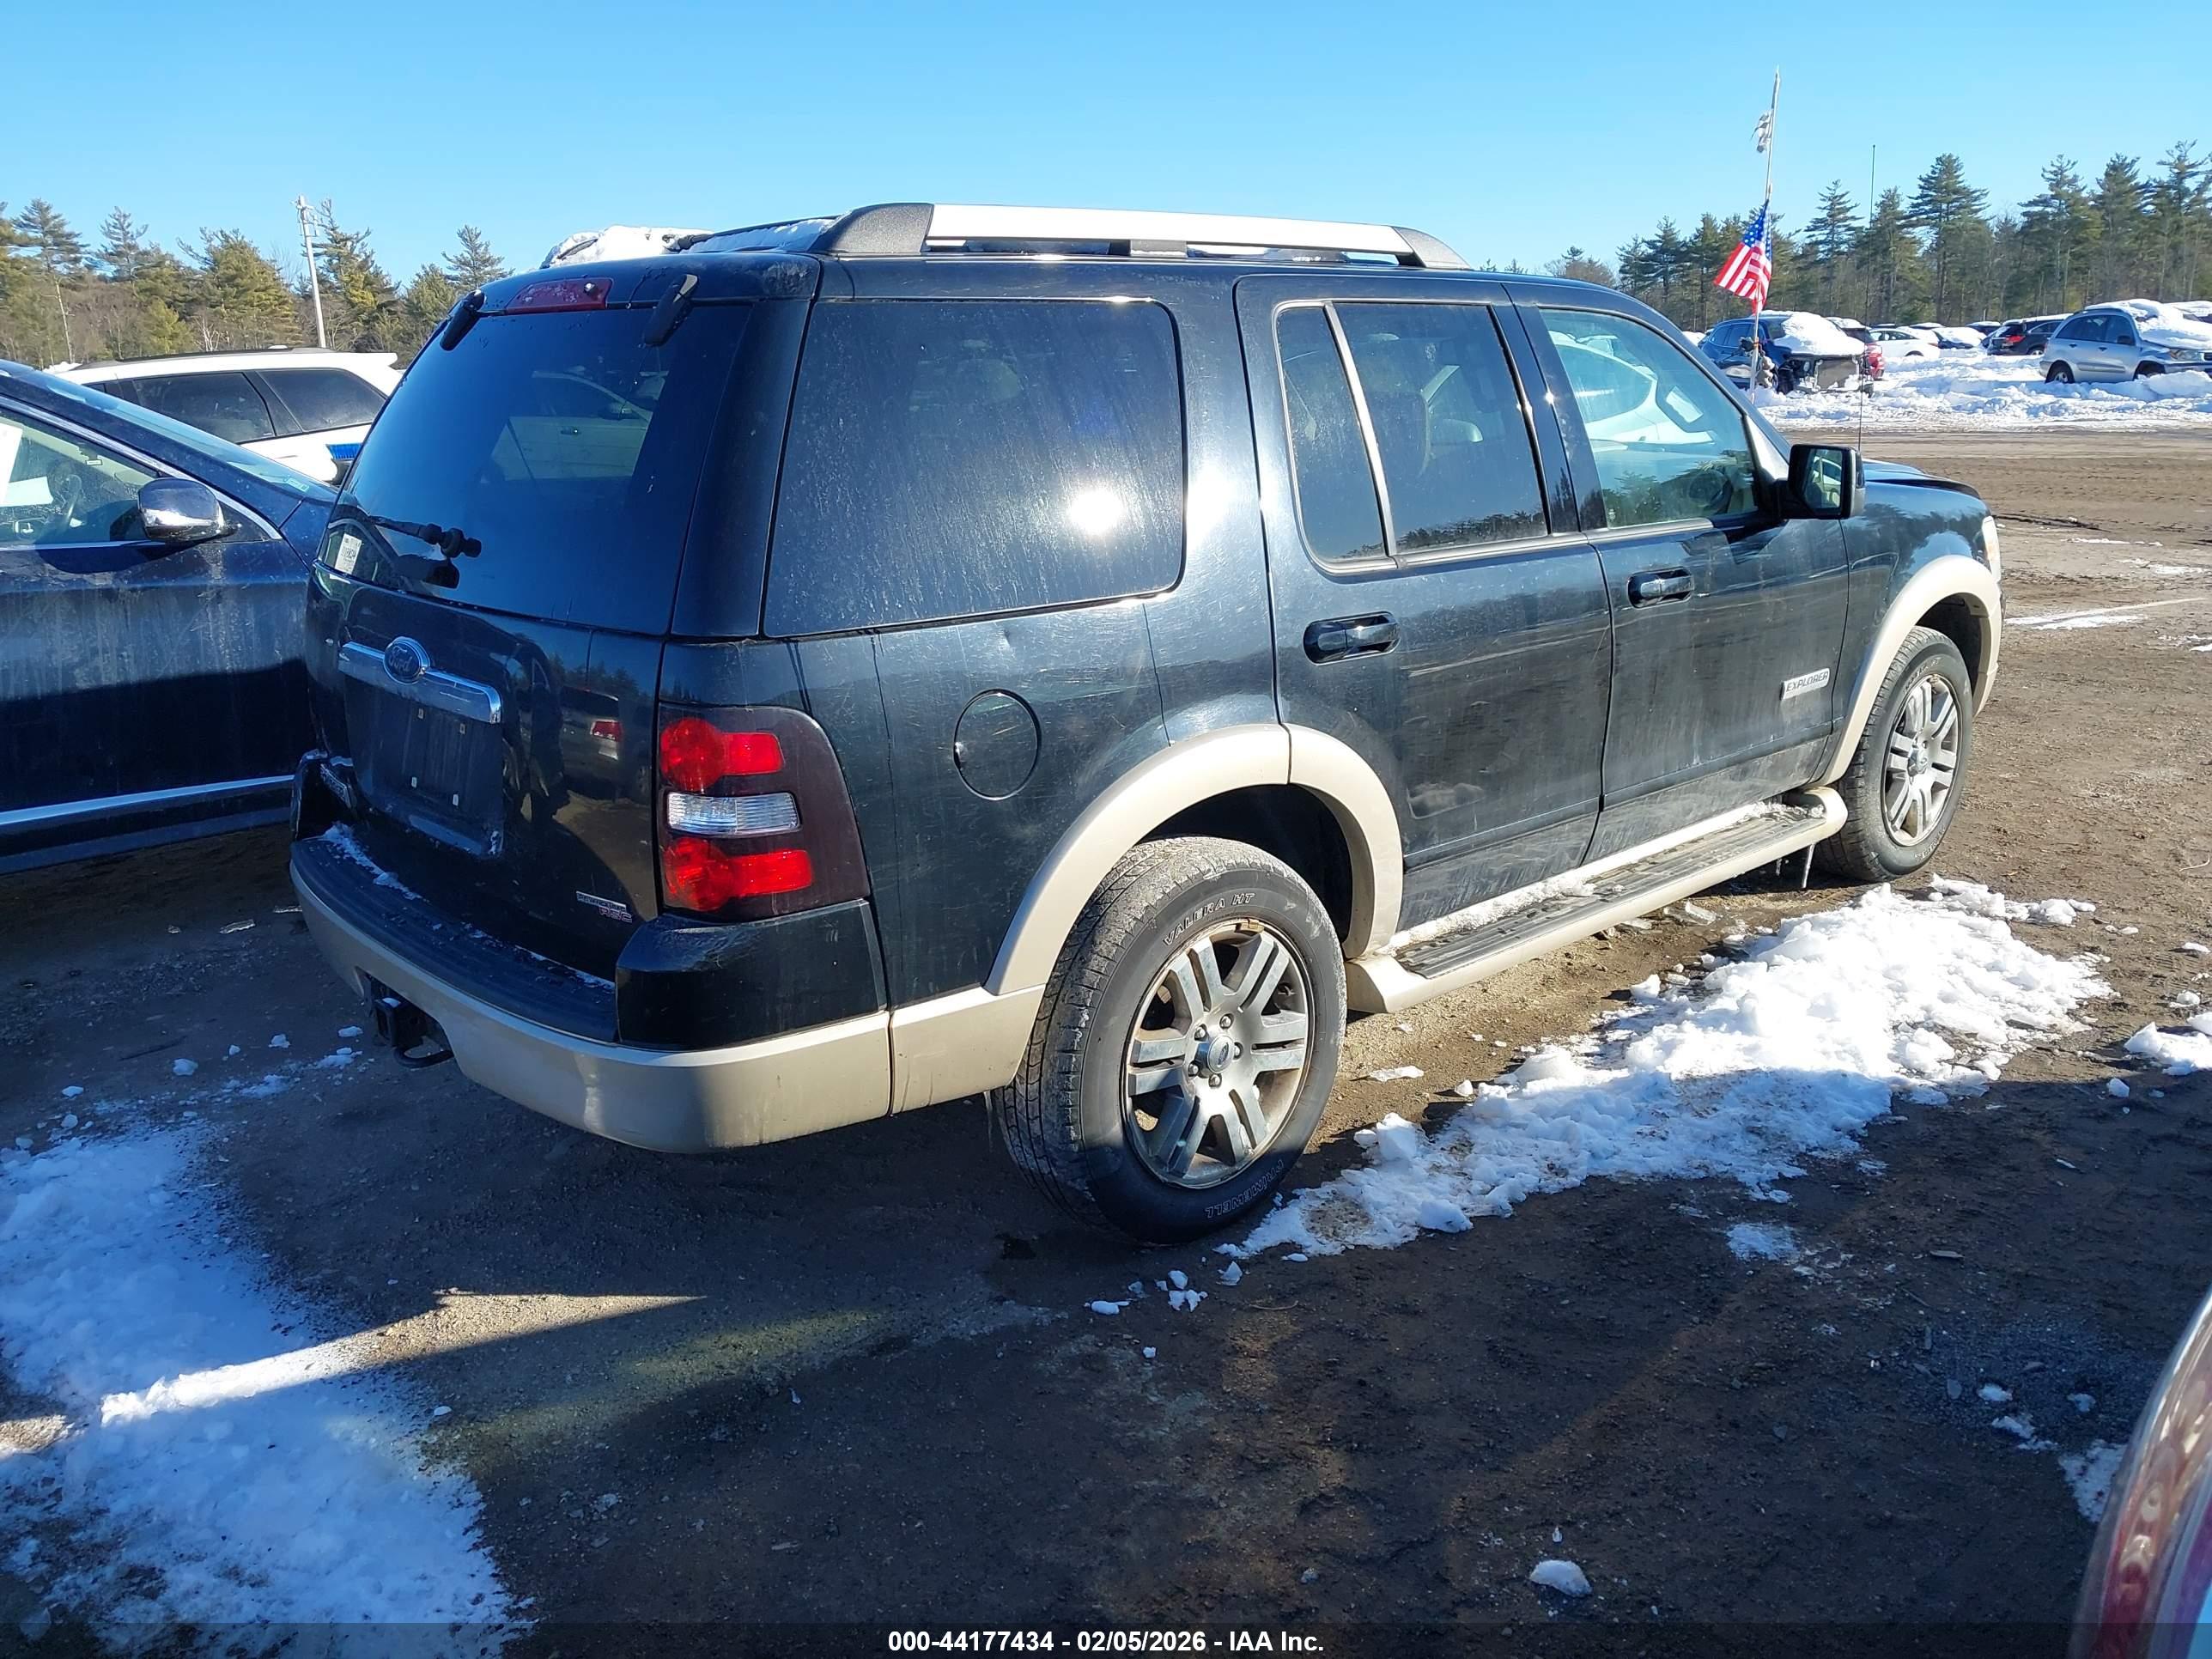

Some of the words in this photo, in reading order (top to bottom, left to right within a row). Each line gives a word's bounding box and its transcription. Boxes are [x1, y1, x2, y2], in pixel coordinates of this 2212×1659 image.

[1785, 671, 1829, 693] EXPLORER
[1163, 897, 1225, 946] VALERA
[1231, 892, 1255, 906] HT
[1205, 1159, 1285, 1218] PRIMEWELL
